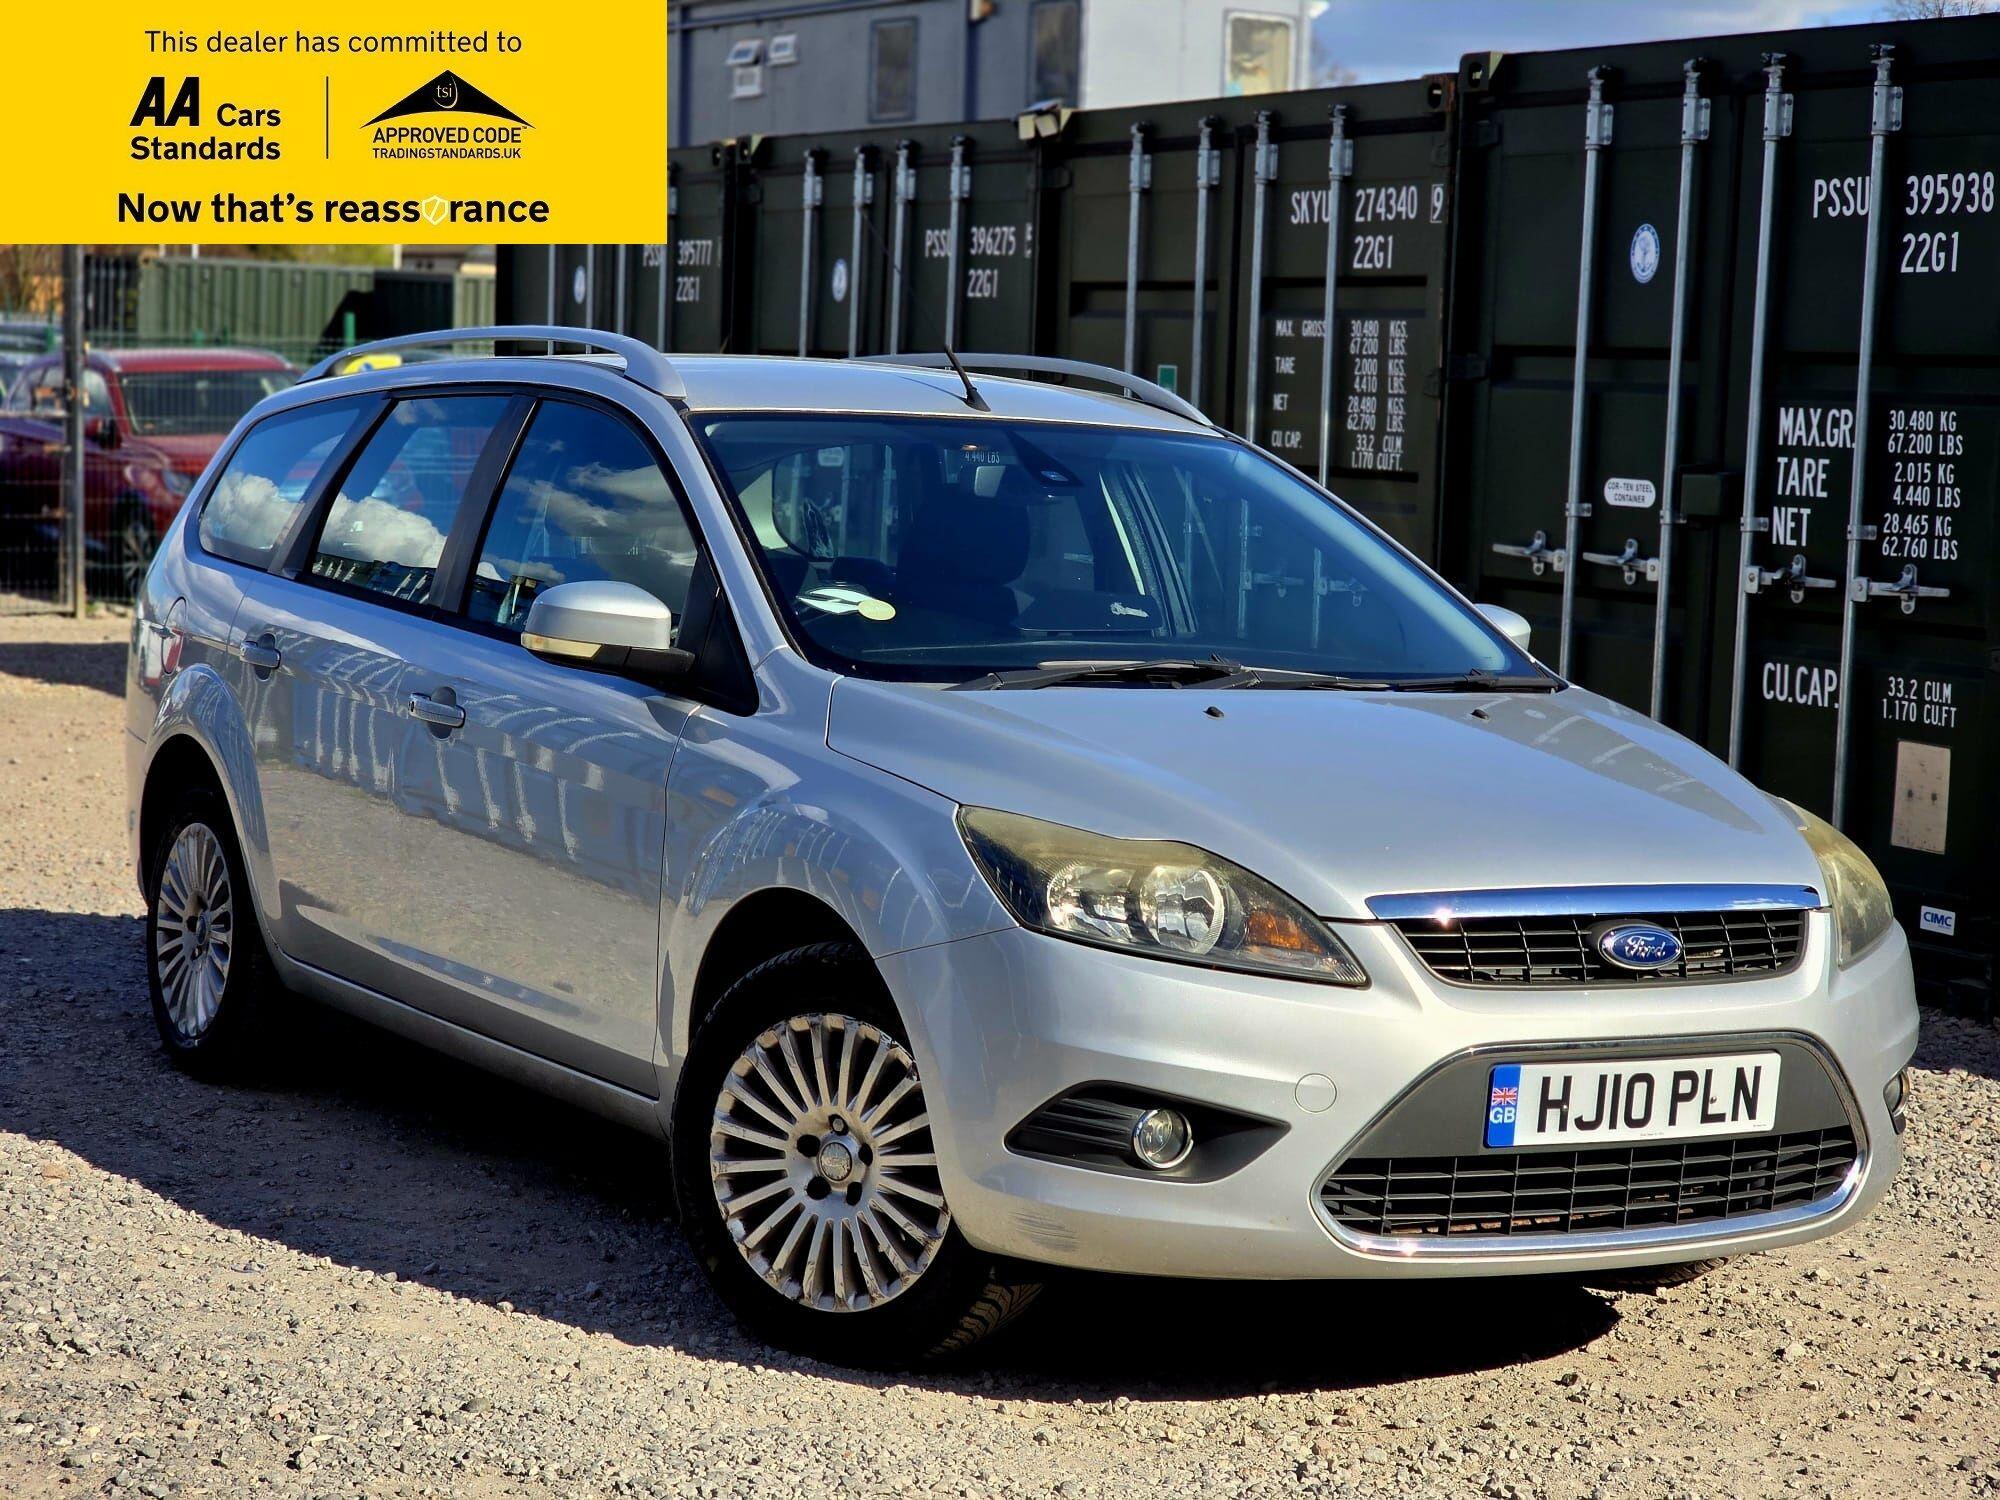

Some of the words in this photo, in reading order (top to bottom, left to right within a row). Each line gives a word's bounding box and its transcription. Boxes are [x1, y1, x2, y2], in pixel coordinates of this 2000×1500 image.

[1290, 190, 1331, 224] SKYU
[1354, 185, 1418, 222] 274340
[1431, 185, 1444, 222] 9
[1812, 176, 1870, 219] PSSU
[1905, 171, 1995, 216] 395938
[677, 240, 712, 266] 395777
[970, 226, 1016, 256] 396275
[1353, 235, 1394, 269] 22G1
[1900, 231, 1960, 273] 22G1
[967, 268, 998, 298] 22G1
[1275, 356, 1296, 374] TARE
[1273, 393, 1289, 411] NET
[1889, 409, 1934, 431] 30.480
[1940, 410, 1957, 432] KG
[1356, 433, 1375, 451] 33.2
[1888, 433, 1933, 454] 67.200
[1939, 434, 1963, 456] LBS
[1351, 451, 1374, 469] 1.170
[1777, 456, 1830, 498] TARE
[1894, 462, 1932, 484] 2.015
[1938, 463, 1955, 485] KG
[1607, 481, 1634, 491] COR-TEN
[1636, 484, 1653, 493] STEEL
[1614, 493, 1646, 503] CONTAINER
[1893, 484, 1931, 506] 4.440
[1936, 486, 1961, 508] LBS
[1772, 506, 1811, 547] NET
[1883, 512, 1929, 535] 28.465
[1935, 515, 1952, 537] KG
[1882, 536, 1928, 558] 62.760
[1933, 538, 1958, 560] LBS
[1763, 662, 1839, 709] CU.CAP.
[1887, 676, 1918, 700] 33.2
[1924, 681, 1952, 704] CU.M
[1882, 698, 1917, 722] 1.170
[1923, 703, 1957, 728] CU.FT
[1923, 911, 1953, 927] CIMC
[1625, 935, 1667, 958] Ford
[1489, 1106, 1516, 1124] GB
[1537, 1072, 1655, 1133] HJ10
[1668, 1065, 1762, 1127] PLN
